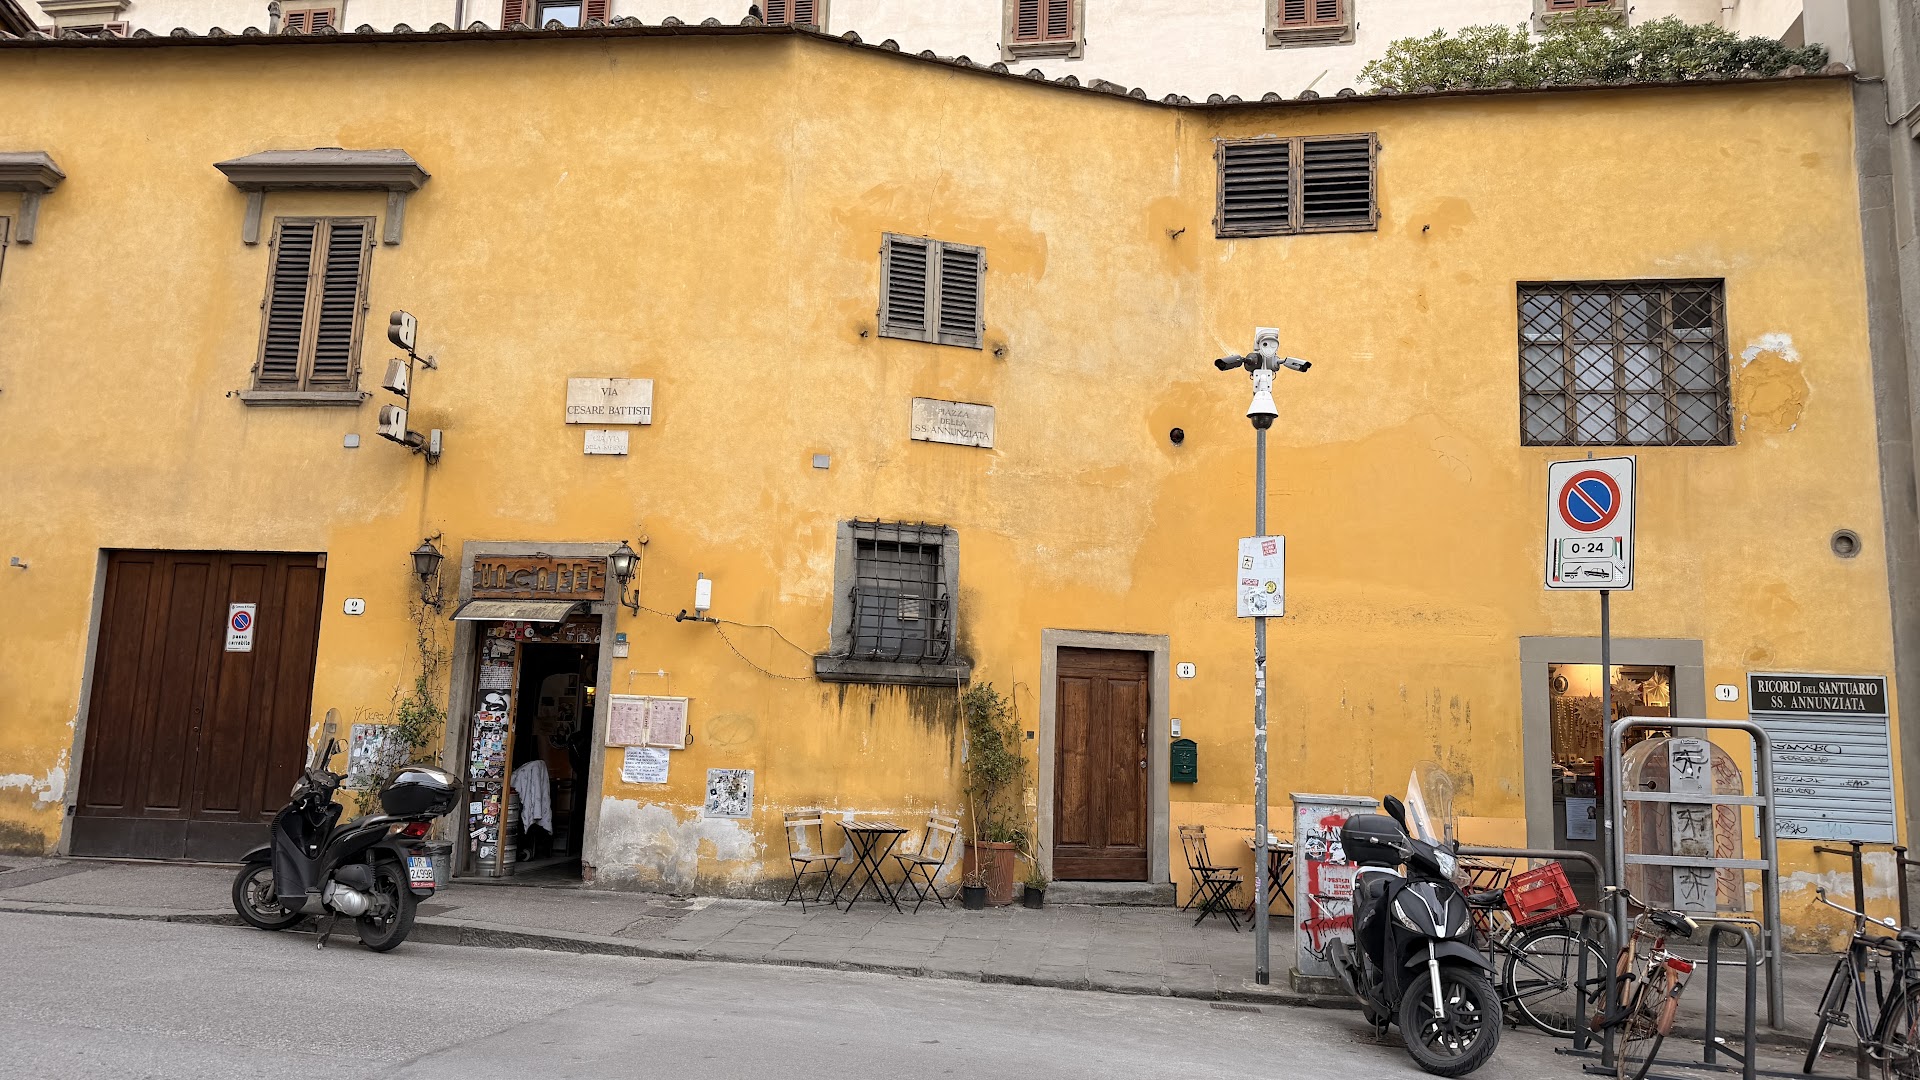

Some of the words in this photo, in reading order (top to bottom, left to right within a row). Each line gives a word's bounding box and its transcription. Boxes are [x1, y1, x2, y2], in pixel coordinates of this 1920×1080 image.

[601, 387, 618, 396] VIA
[567, 405, 605, 415] CESARE
[608, 406, 651, 416] BATTISTI
[938, 408, 969, 418] PIAZZA
[940, 418, 967, 427] DELLA
[930, 426, 990, 440] ANNUNZIATA
[1571, 542, 1604, 554] 0-24
[351, 600, 358, 612] 2
[1183, 664, 1189, 676] 8
[1723, 687, 1730, 699] 9
[1757, 680, 1800, 694] RICORDI
[1802, 685, 1818, 695] DEL
[1818, 682, 1878, 696] SANTUARIO
[1770, 695, 1786, 709] SS.
[1790, 696, 1866, 711] ANNUNZIATA
